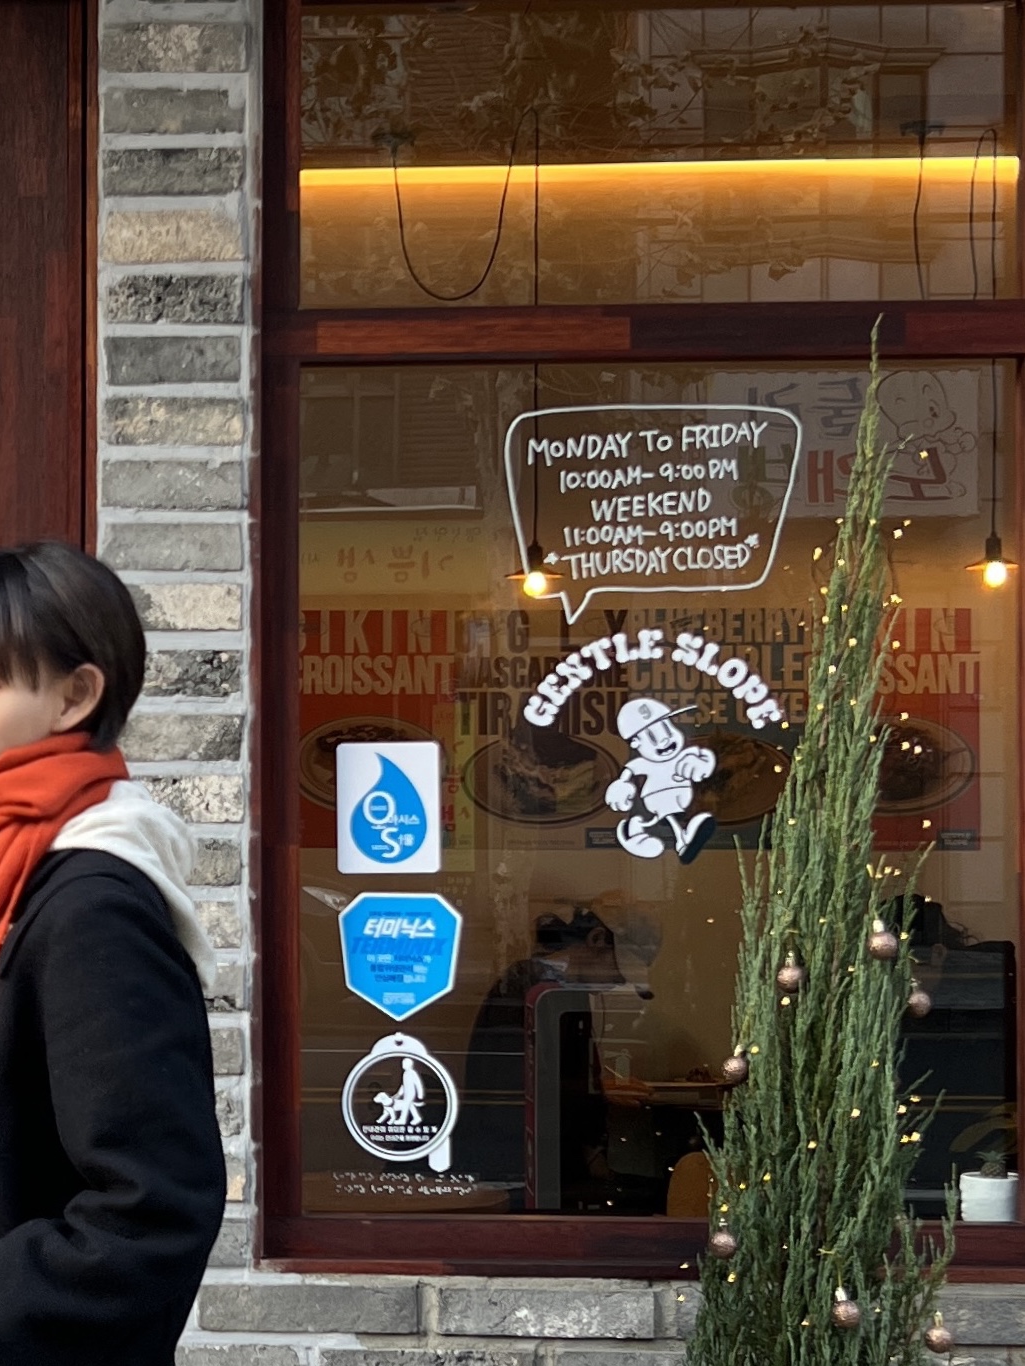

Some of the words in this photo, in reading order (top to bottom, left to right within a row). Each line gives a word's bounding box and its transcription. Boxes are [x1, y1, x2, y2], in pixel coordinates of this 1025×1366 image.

[528, 431, 632, 466] MONDAY
[681, 421, 768, 452] FRIDAY
[591, 487, 712, 522] WEEKEND
[560, 547, 675, 580] THURSDAY
[674, 544, 750, 572] CLOSED
[299, 655, 454, 695] ROISSANT
[524, 629, 664, 726] GENTLE
[672, 632, 782, 729] SLOPE
[363, 917, 436, 938] 터미닉스
